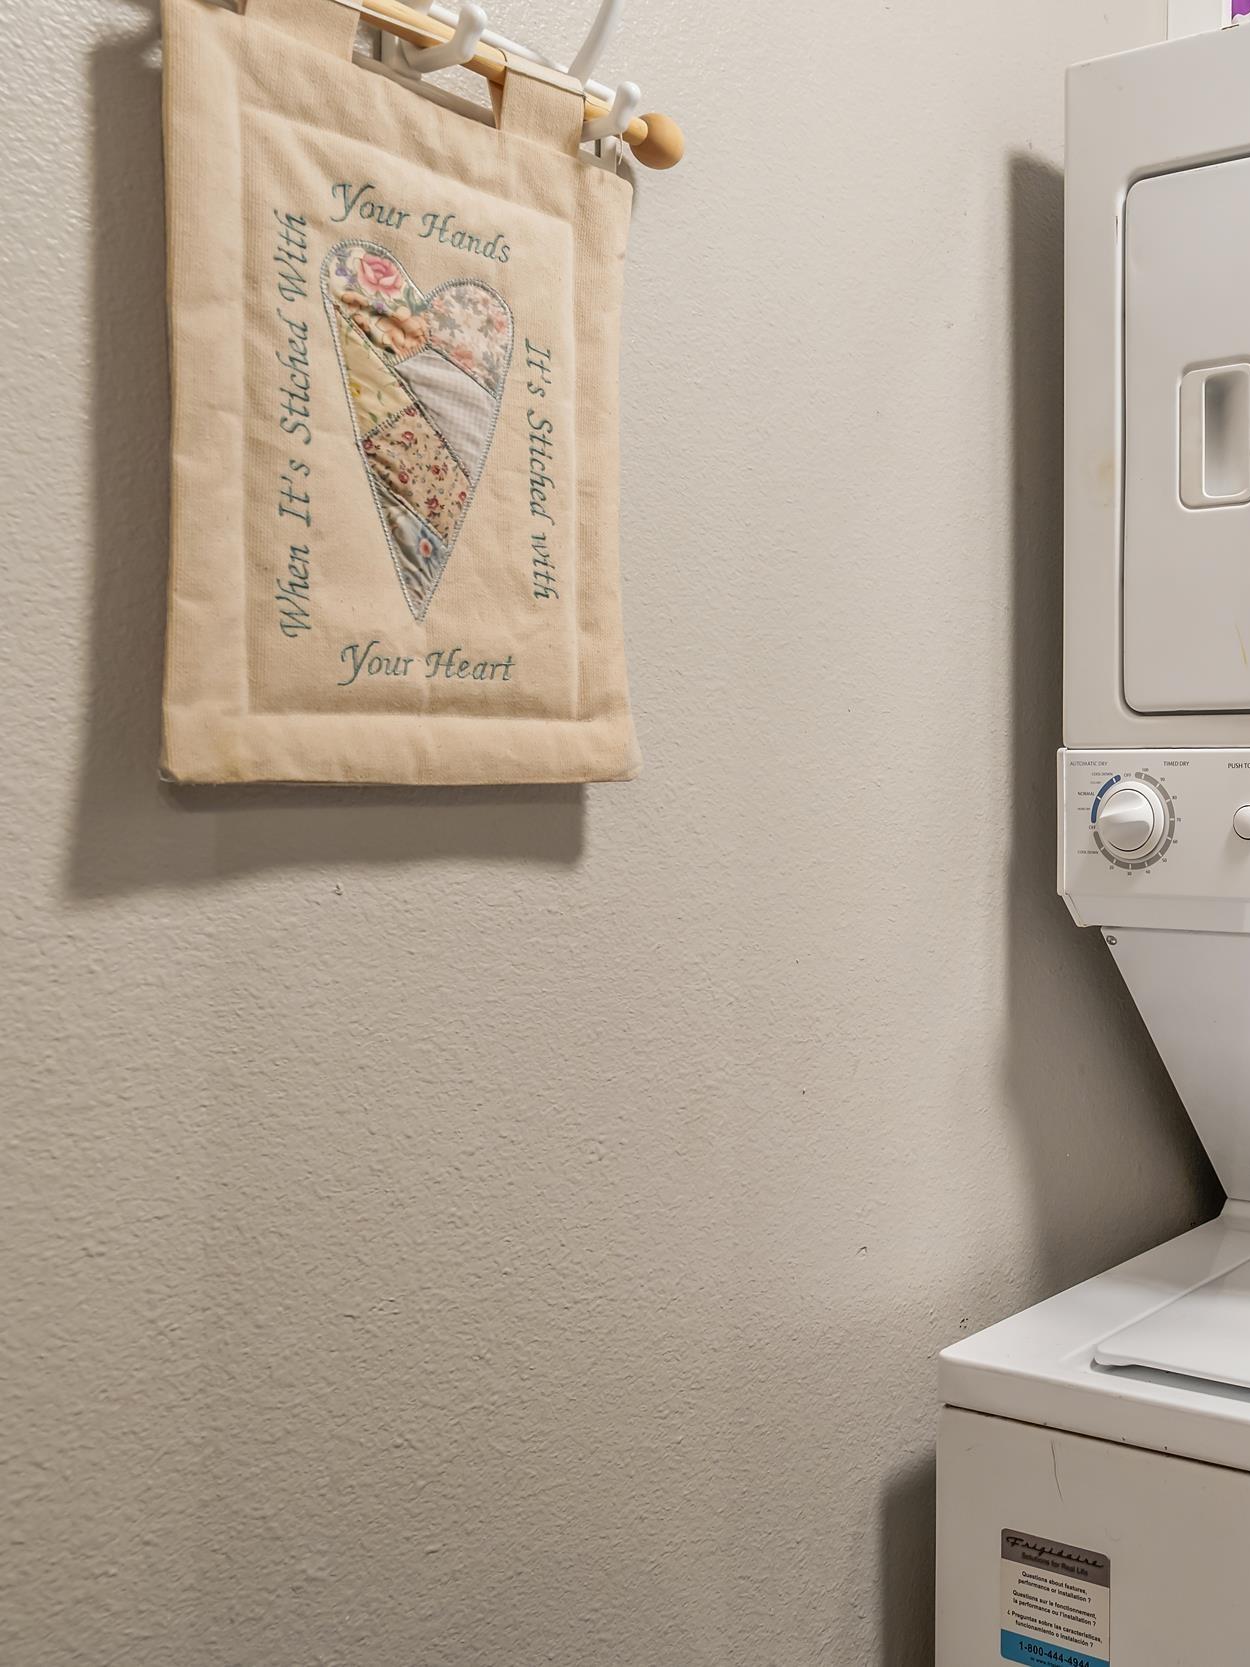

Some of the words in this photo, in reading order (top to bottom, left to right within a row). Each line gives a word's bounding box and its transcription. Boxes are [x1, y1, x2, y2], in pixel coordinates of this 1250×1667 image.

[331, 182, 409, 231] Your
[418, 211, 511, 264] Hands
[272, 209, 307, 305] With
[525, 337, 553, 399] It's
[278, 457, 312, 528] It's
[275, 543, 312, 639] When
[530, 532, 560, 600] with
[337, 640, 415, 686] Your
[424, 645, 515, 682] Heart
[1006, 1536, 1104, 1568] Frigidaire
[1021, 1571, 1048, 1583] Questions
[1012, 1589, 1039, 1602] Questions
